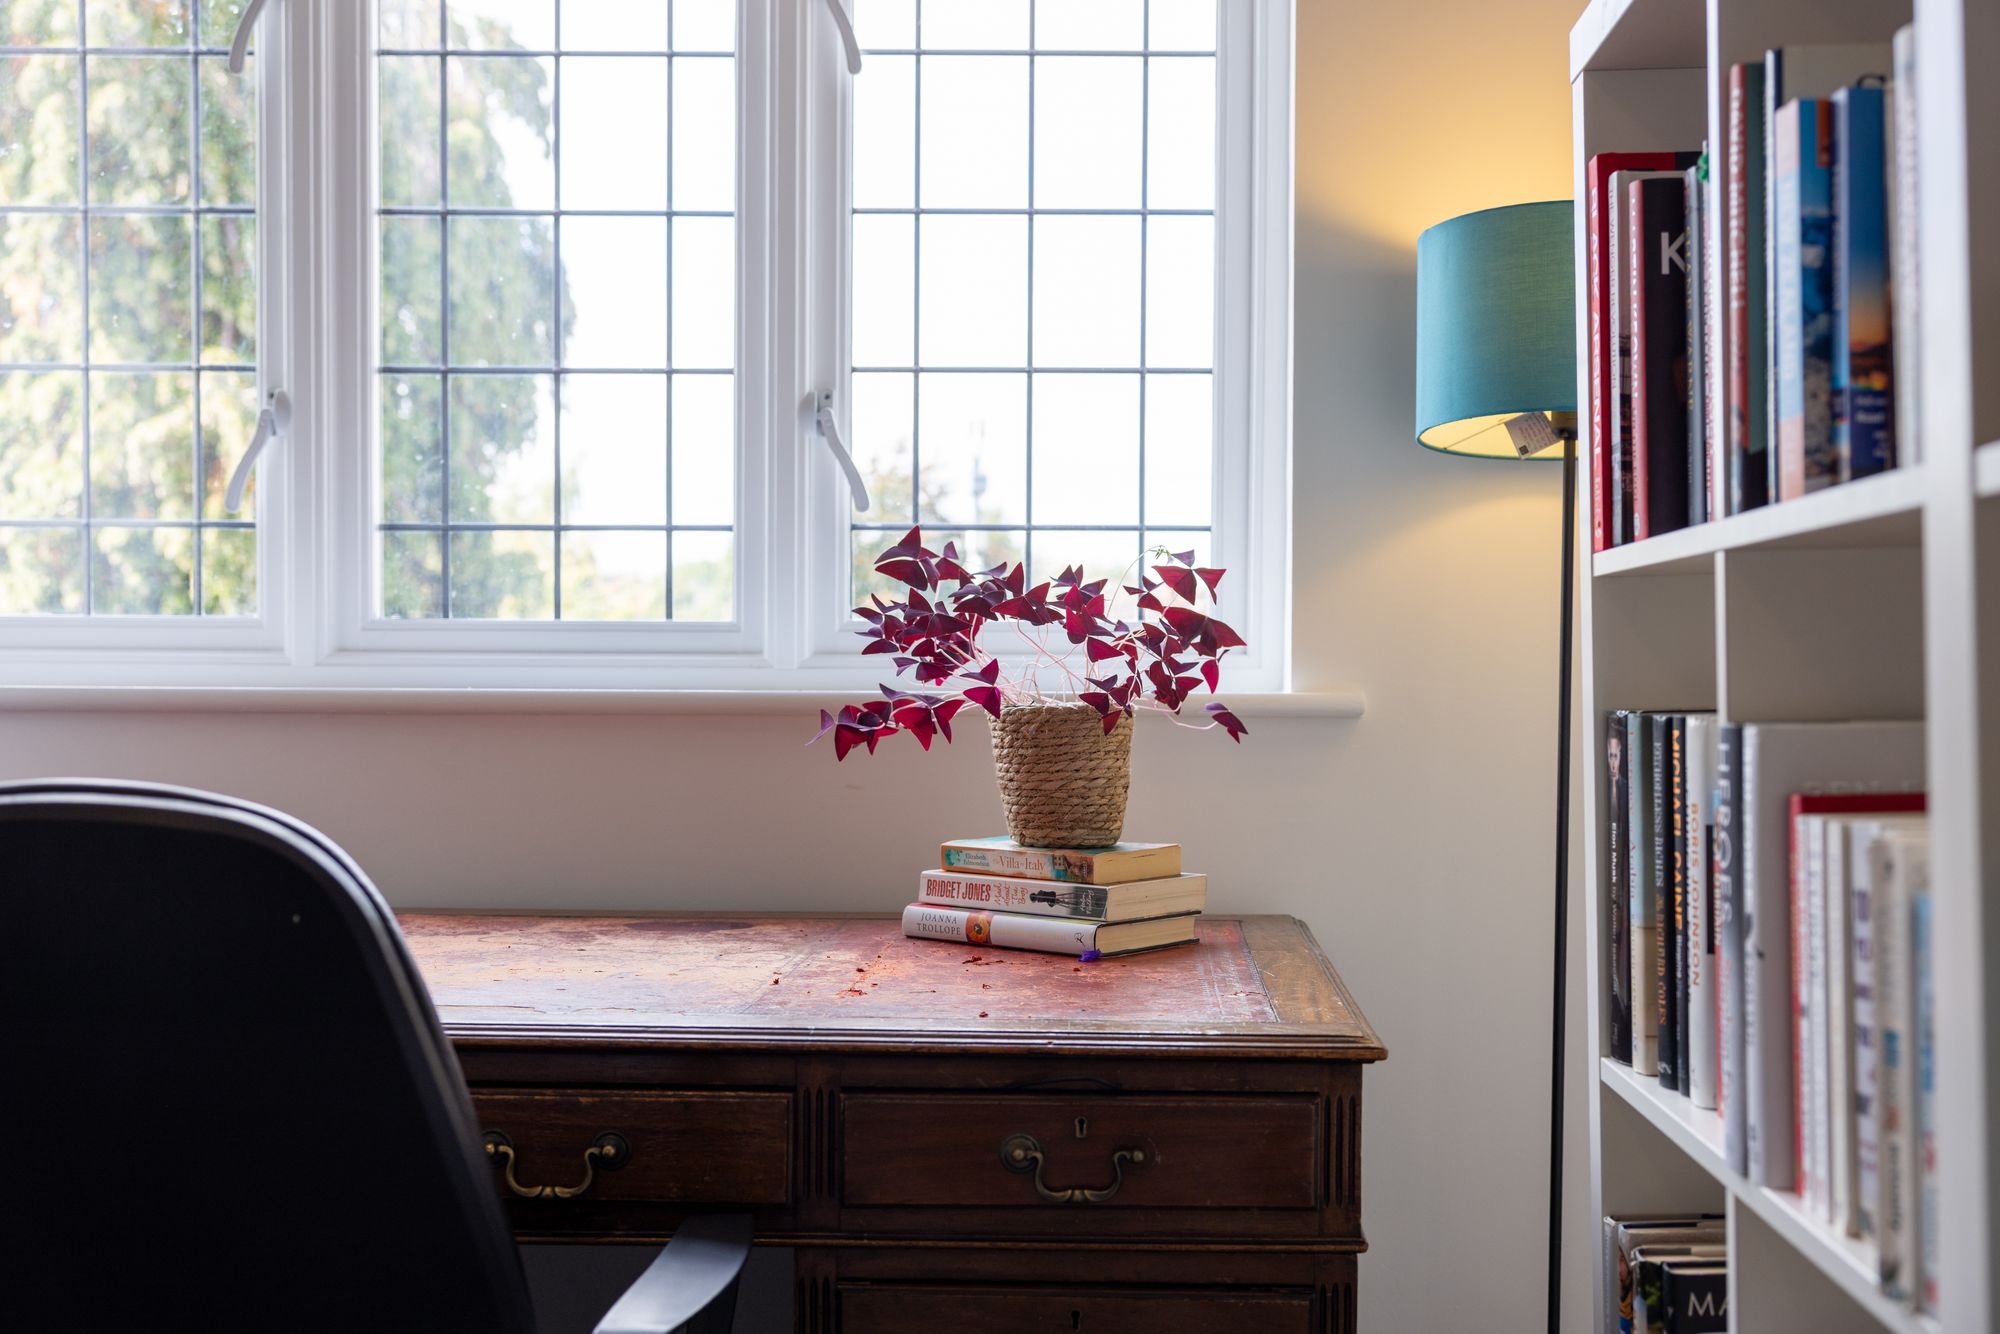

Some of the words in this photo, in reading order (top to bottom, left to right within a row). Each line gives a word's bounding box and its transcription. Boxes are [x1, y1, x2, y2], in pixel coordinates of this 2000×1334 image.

[1729, 86, 1745, 174] DAVID
[1591, 187, 1600, 299] BLACK
[1729, 181, 1746, 309] MITCHELL
[1610, 293, 1618, 389] REVOLUTION
[1631, 303, 1639, 398] KEOWN
[1593, 312, 1602, 470] ARSENAL
[1672, 730, 1682, 836] MICHAEL
[965, 852, 986, 861] Elizabeth
[1000, 855, 1020, 869] Villa
[1025, 857, 1045, 874] Italy
[1655, 836, 1666, 888] RICHES
[1691, 802, 1701, 868] BORIS
[1717, 742, 1733, 922] HEROES
[920, 912, 957, 924] JOANNA
[926, 879, 961, 899] BRIDGET
[962, 882, 992, 902] JONES
[993, 881, 1002, 905] Mad
[1673, 851, 1683, 932] CAINE
[917, 922, 961, 936] TROLLOPE
[1656, 912, 1666, 976] RICHARD
[1692, 879, 1701, 987] JOHNSON
[1657, 981, 1668, 1025] COLES
